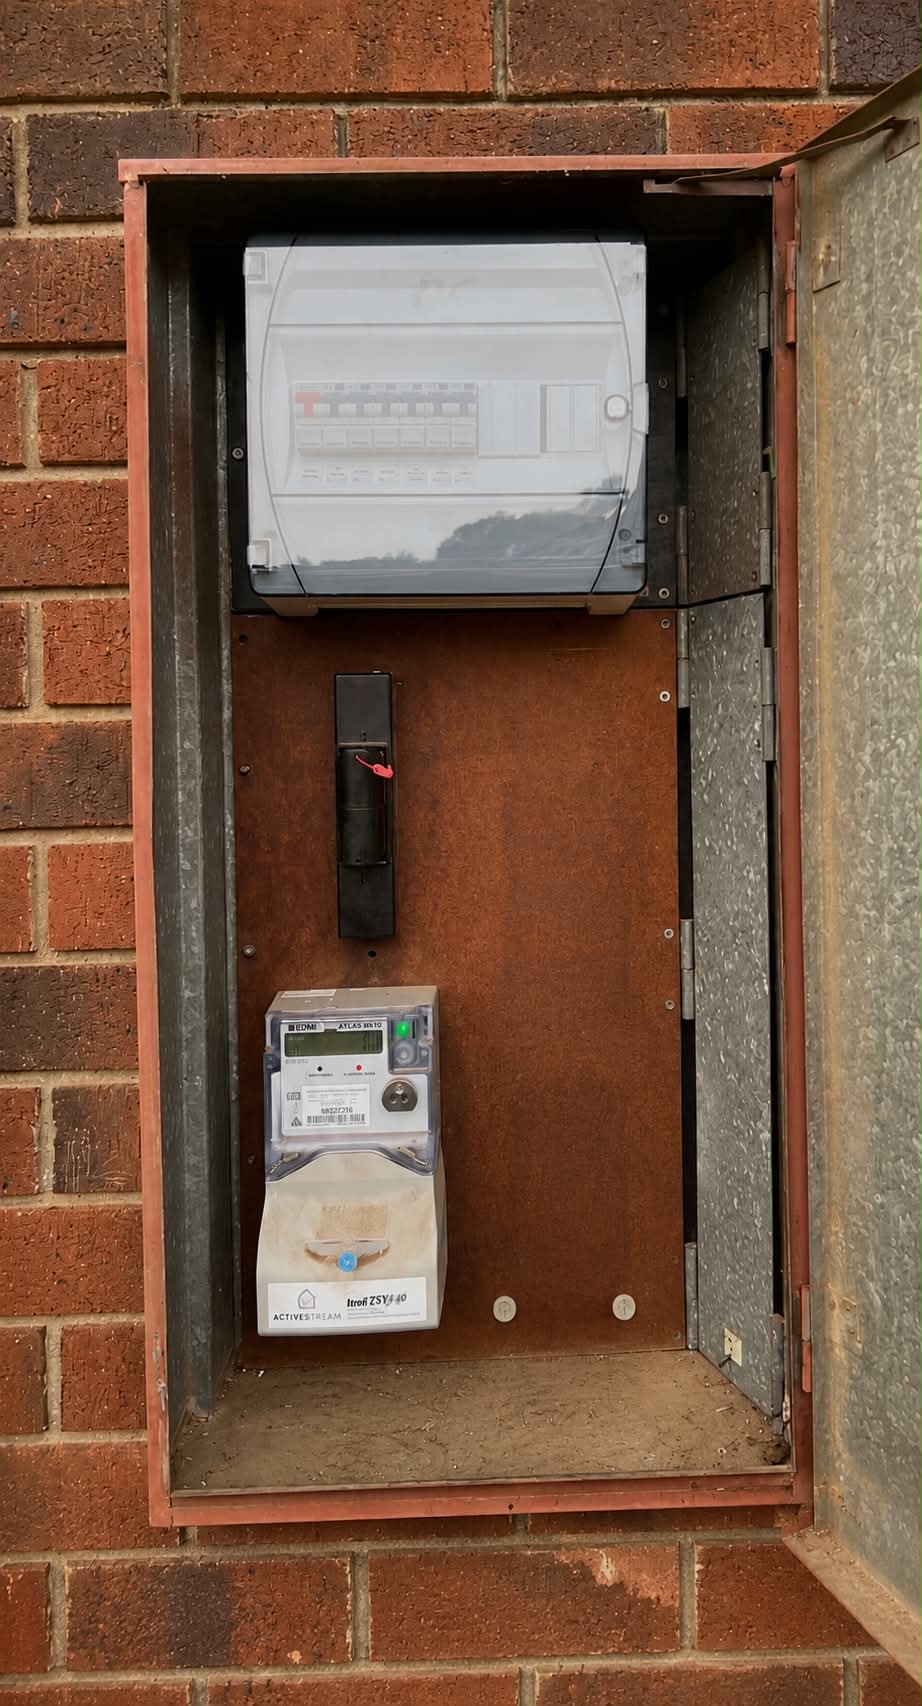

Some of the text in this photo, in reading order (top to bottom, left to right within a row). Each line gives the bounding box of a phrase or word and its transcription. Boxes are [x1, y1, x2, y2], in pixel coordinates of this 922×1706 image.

[296, 1023, 317, 1032] EDMI
[338, 1022, 362, 1030] ATLAS
[273, 1313, 342, 1321] ACTIVESTREAM
